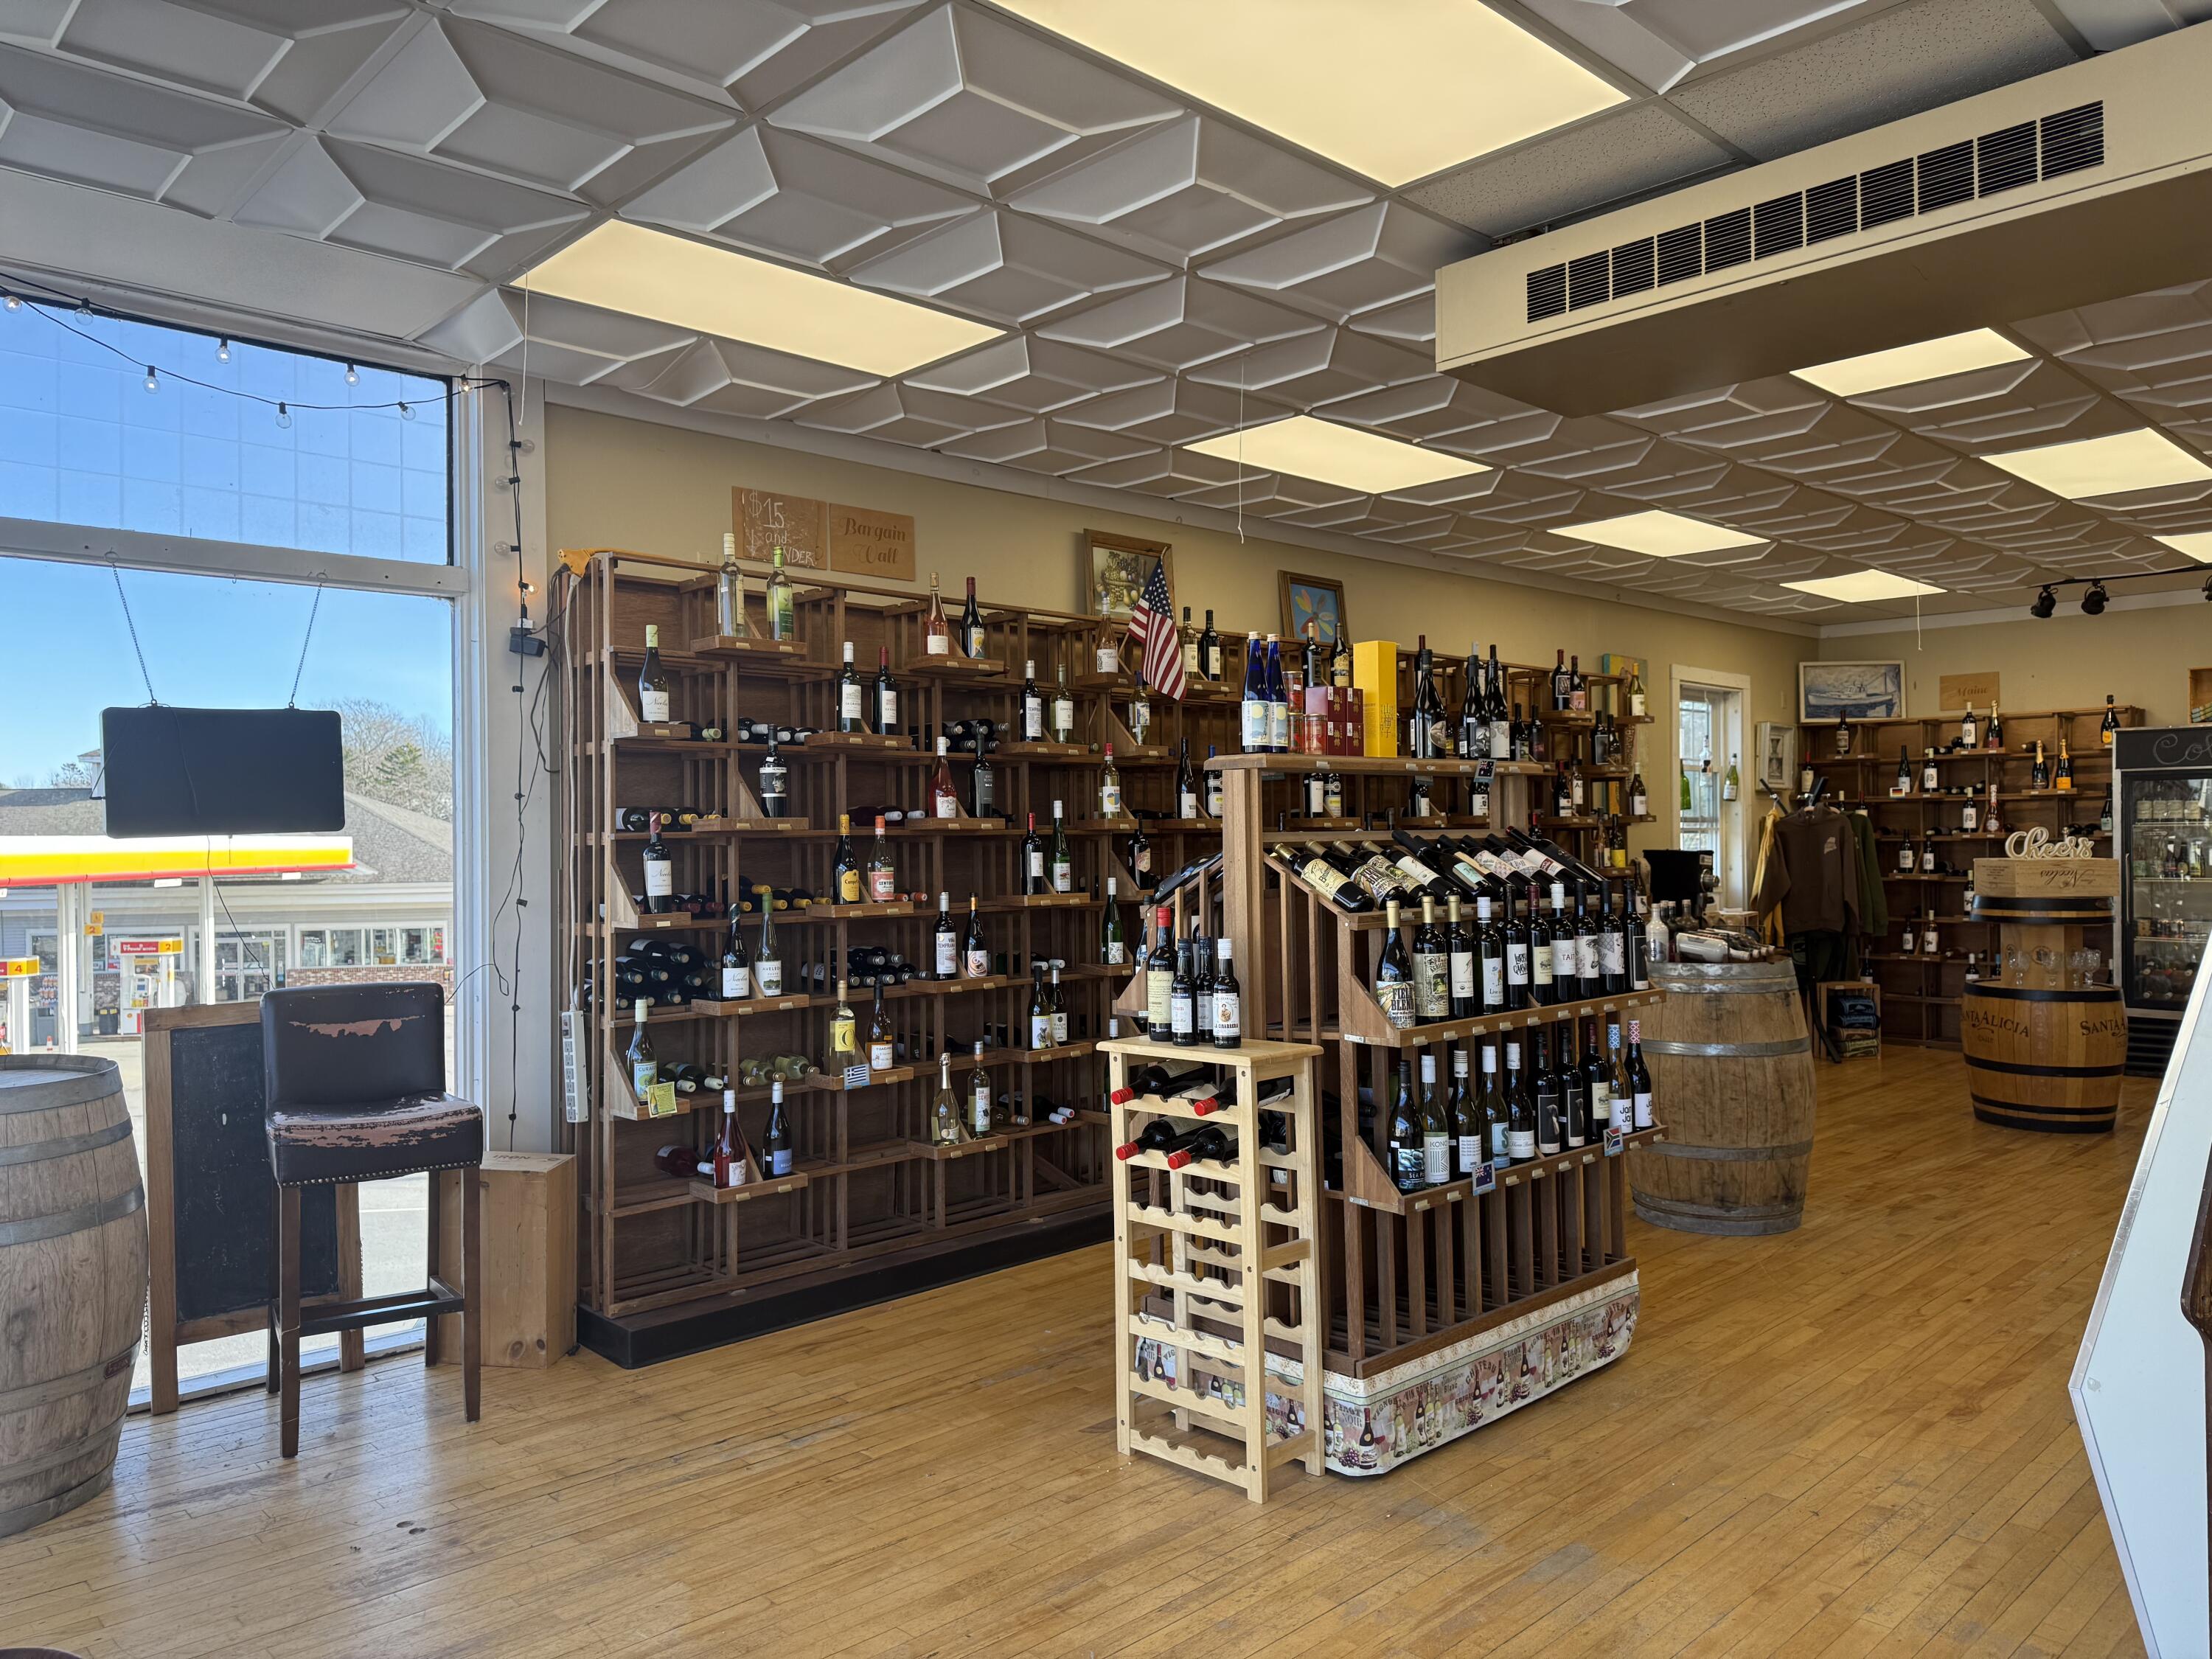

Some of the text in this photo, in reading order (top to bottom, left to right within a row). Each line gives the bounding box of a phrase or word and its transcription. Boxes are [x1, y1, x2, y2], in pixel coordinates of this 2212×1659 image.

[749, 490, 785, 528] $15
[765, 530, 787, 546] and
[839, 517, 906, 542] Bargain
[853, 543, 898, 564] Wall
[1958, 686, 1989, 698] Maine
[2005, 826, 2095, 859] Cheers
[2040, 868, 2094, 888] Nicolas
[15, 964, 23, 973] 4
[1972, 1010, 2029, 1037] ALICIA
